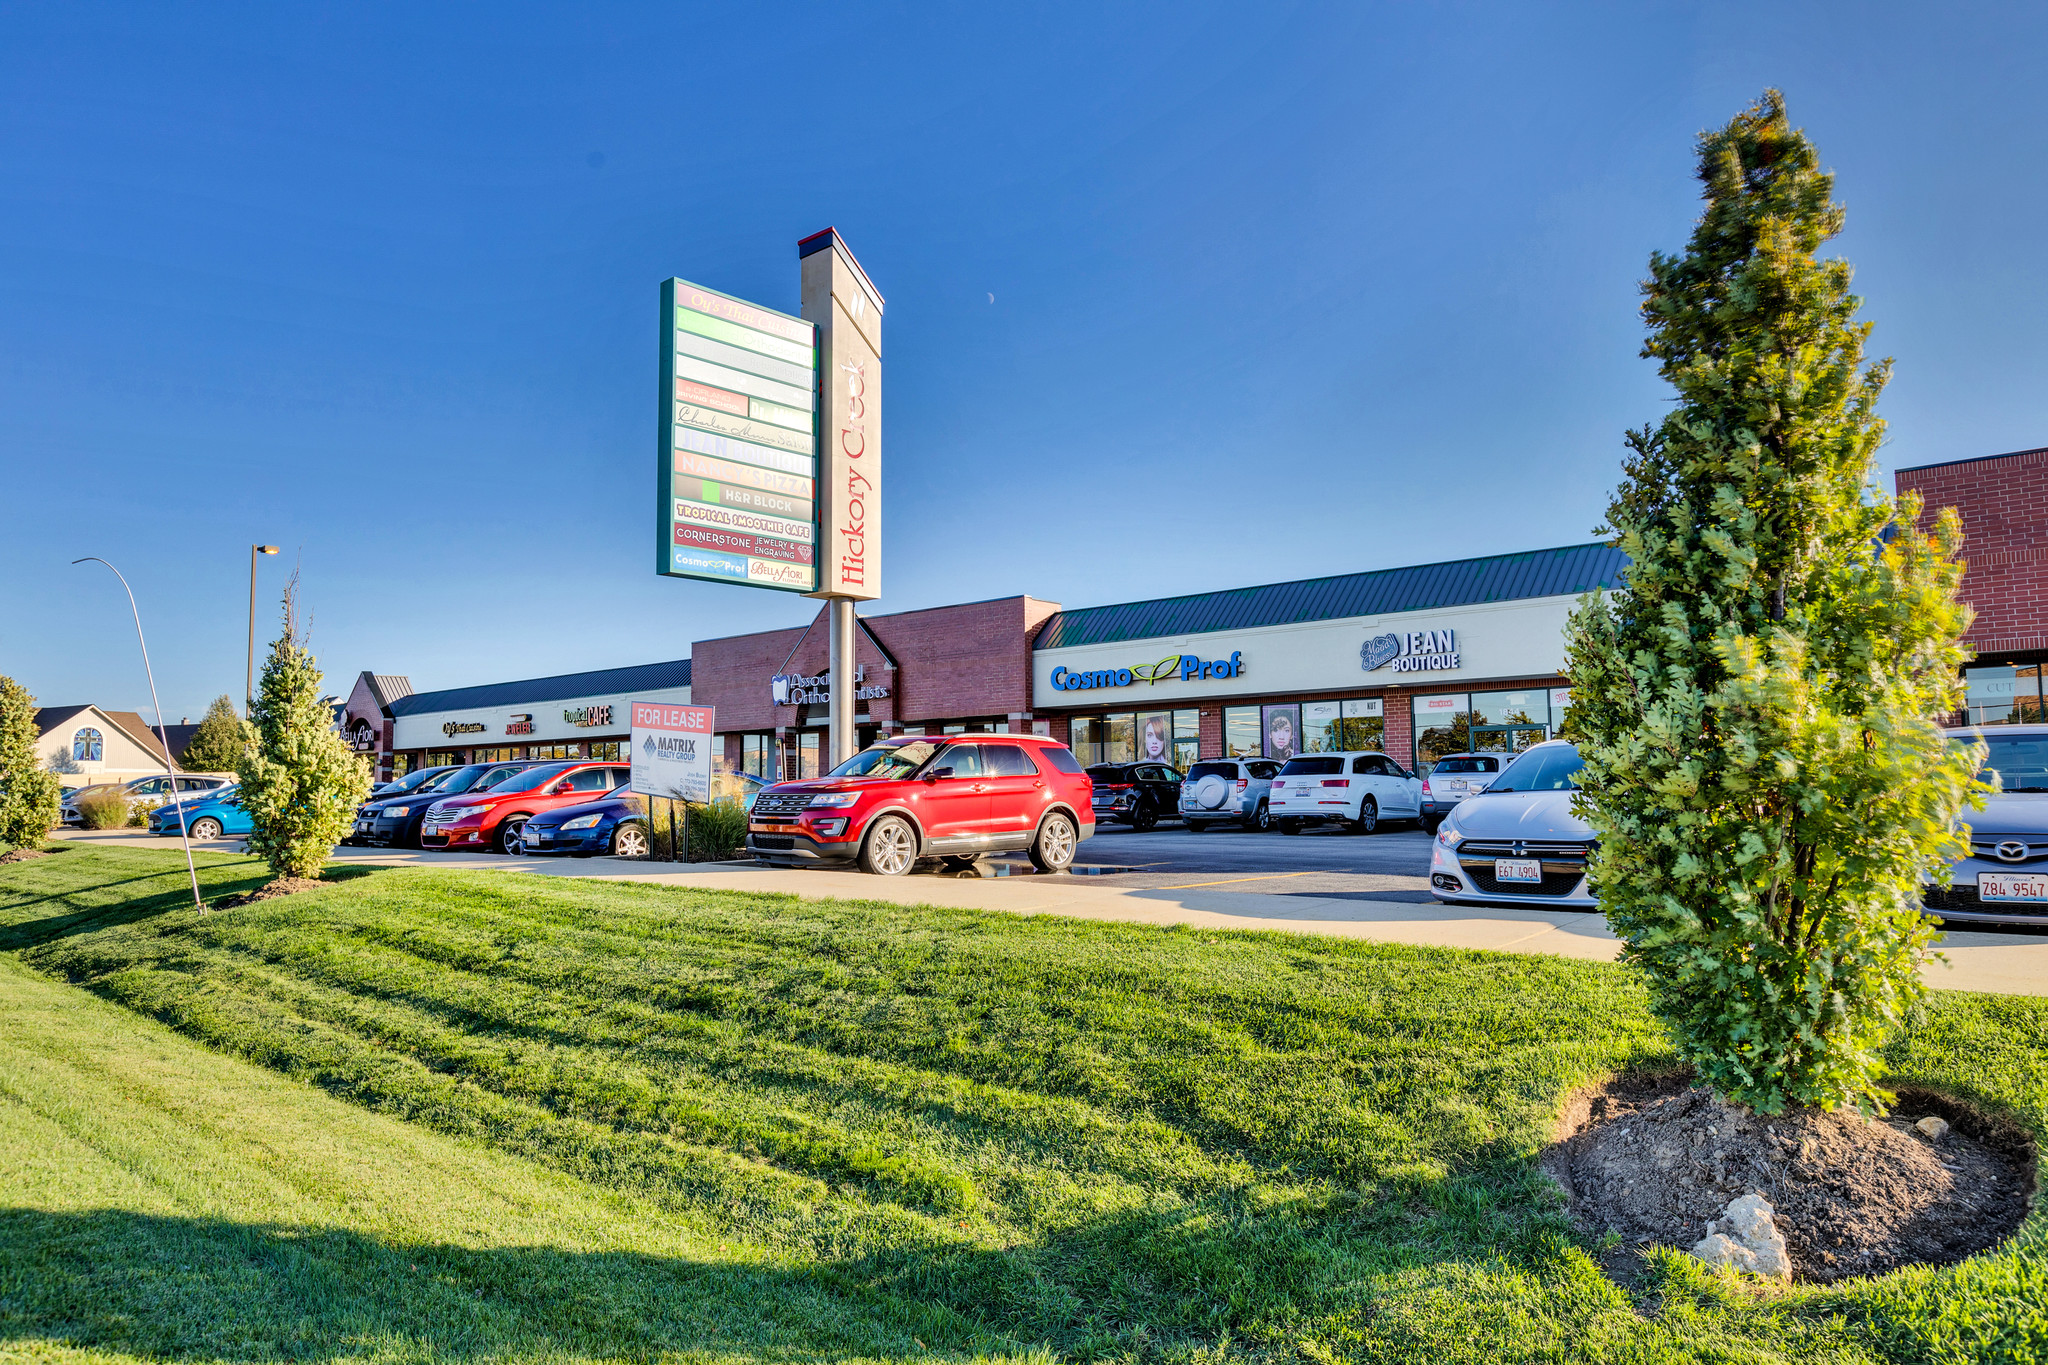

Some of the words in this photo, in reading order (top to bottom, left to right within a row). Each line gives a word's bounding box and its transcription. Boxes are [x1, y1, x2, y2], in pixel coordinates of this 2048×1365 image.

[691, 293, 720, 313] Oy's
[723, 302, 755, 323] Thai
[709, 398, 742, 412] SCHOOL
[840, 358, 865, 459] Creek
[682, 430, 728, 456] JEAN
[682, 455, 761, 486] NANCY'S
[764, 472, 810, 495] PIZZA
[725, 489, 751, 505] H&R
[753, 495, 792, 512] BLOCK
[676, 503, 731, 524] TROPICAL
[732, 513, 784, 534] SMOOTHIE
[785, 523, 811, 538] CAFE
[840, 465, 872, 587] Hickory
[676, 528, 752, 548] CORNERSTONE
[754, 536, 788, 550] JEWELRY
[675, 553, 709, 568] Cosmo
[724, 561, 745, 573] Prof
[754, 546, 795, 559] ENGRAVING
[1401, 629, 1455, 656] JEAN
[1050, 666, 1132, 691] Cosmo
[1180, 651, 1242, 681] Prof
[1391, 653, 1460, 673] BOUTIQUE
[790, 664, 864, 689] Associd
[791, 682, 889, 705] Orthontists
[588, 705, 611, 726] CAFE
[637, 708, 660, 725] FOR
[663, 710, 705, 729] LEASE
[657, 736, 696, 754] MATRIX
[657, 749, 675, 759] REALTY
[675, 751, 696, 762] GROUP
[1498, 866, 1514, 877] E67
[1518, 866, 1538, 878] 4904
[1982, 881, 2006, 896] Z84
[2013, 882, 2044, 897] 9547
